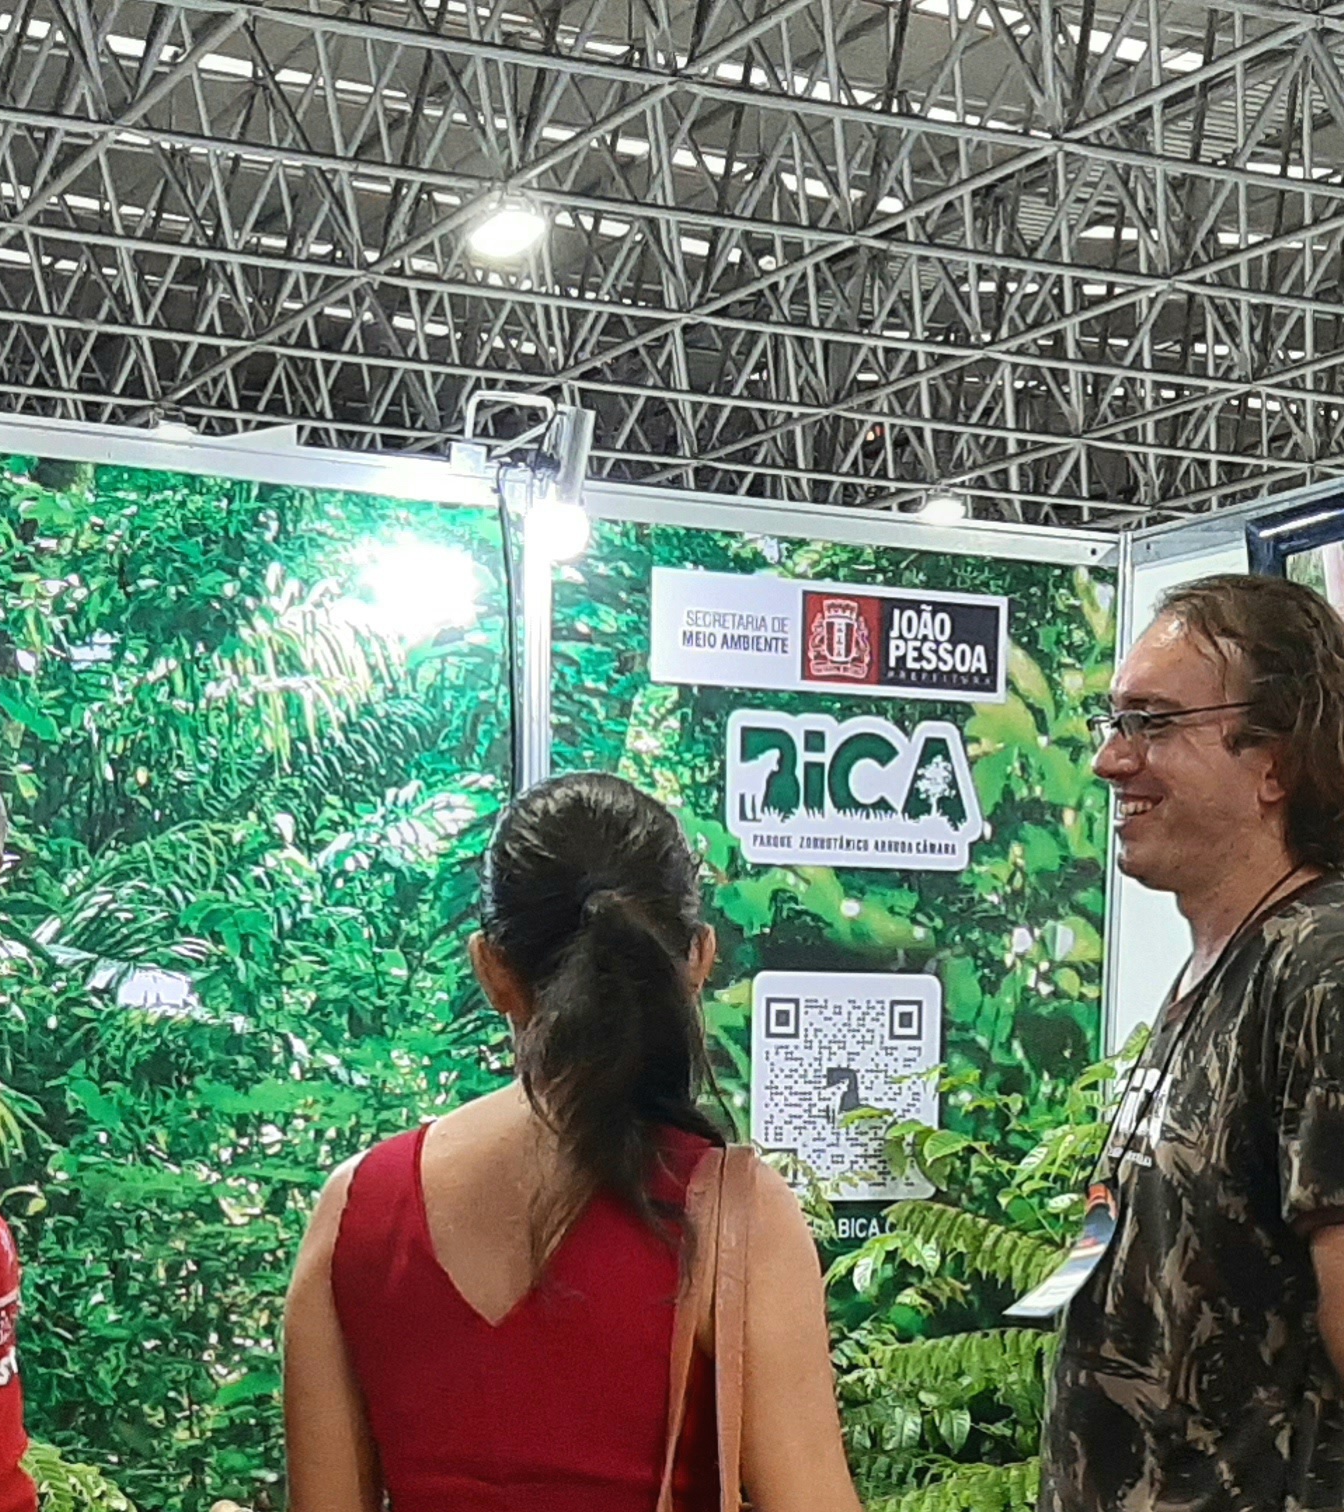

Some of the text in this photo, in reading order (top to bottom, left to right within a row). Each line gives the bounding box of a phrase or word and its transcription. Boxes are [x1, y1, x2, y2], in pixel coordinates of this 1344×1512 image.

[686, 609, 790, 634] SECRETARIA DE
[889, 604, 952, 642] JOÃO
[682, 629, 789, 654] MEIO AMBIENTE
[888, 639, 988, 674] PESSOA
[752, 833, 793, 848] PARQUE
